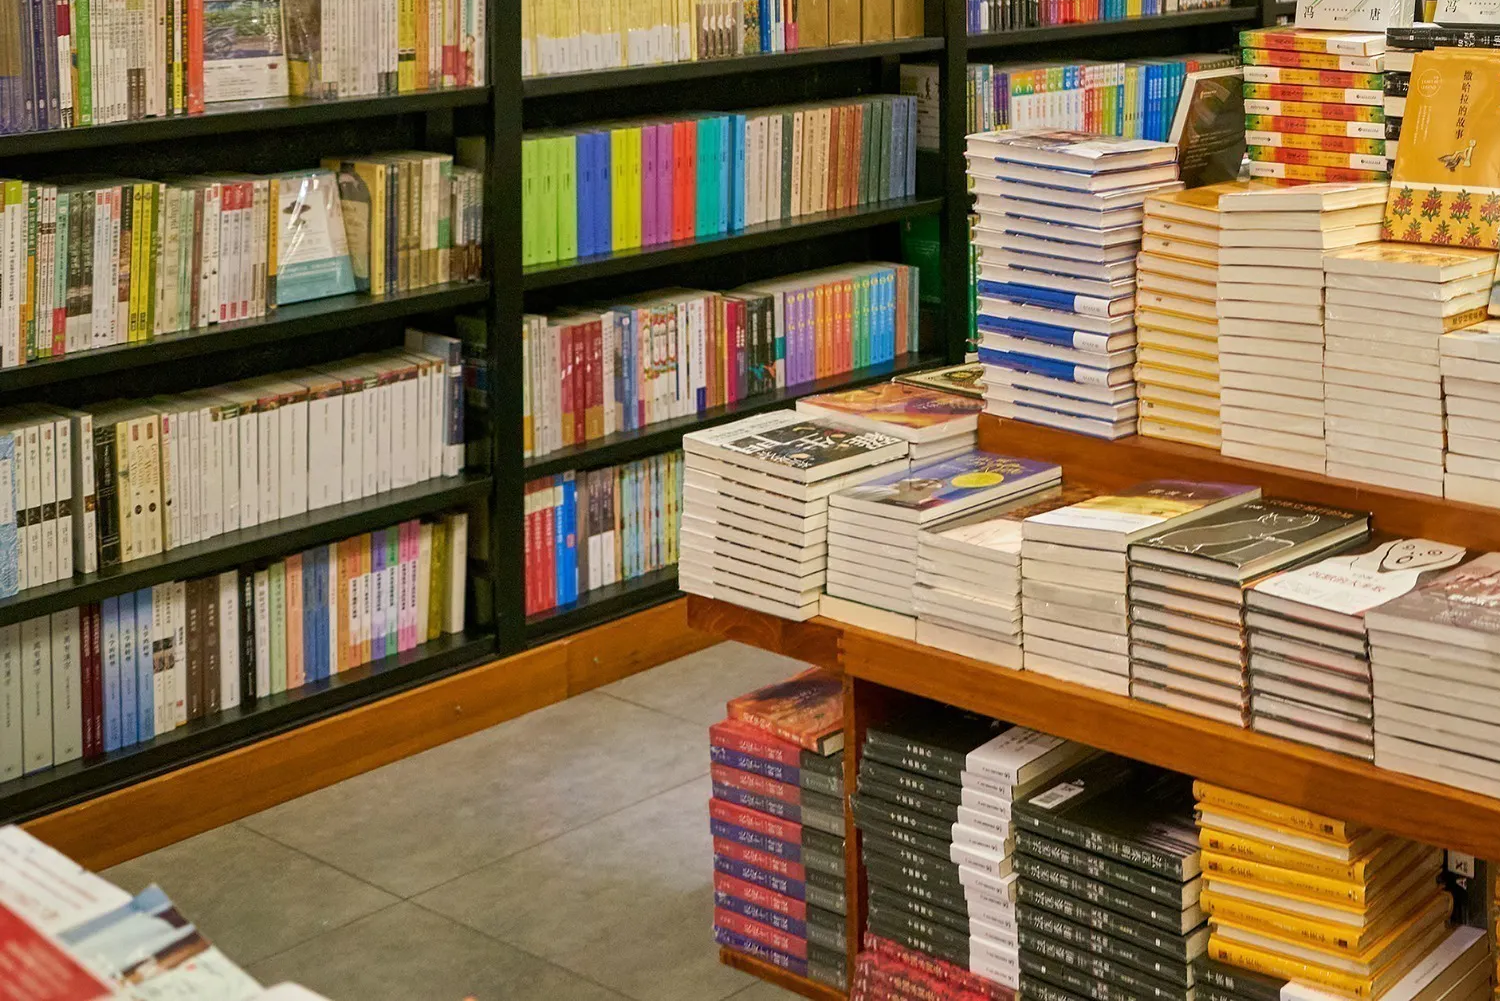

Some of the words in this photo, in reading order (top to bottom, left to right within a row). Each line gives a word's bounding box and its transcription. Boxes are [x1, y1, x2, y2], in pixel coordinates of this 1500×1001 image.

[1304, 6, 1315, 19] 冯
[1445, 0, 1457, 13] 冯
[1370, 8, 1381, 21] 唐
[1455, 71, 1473, 140] 撒哈拉的故事
